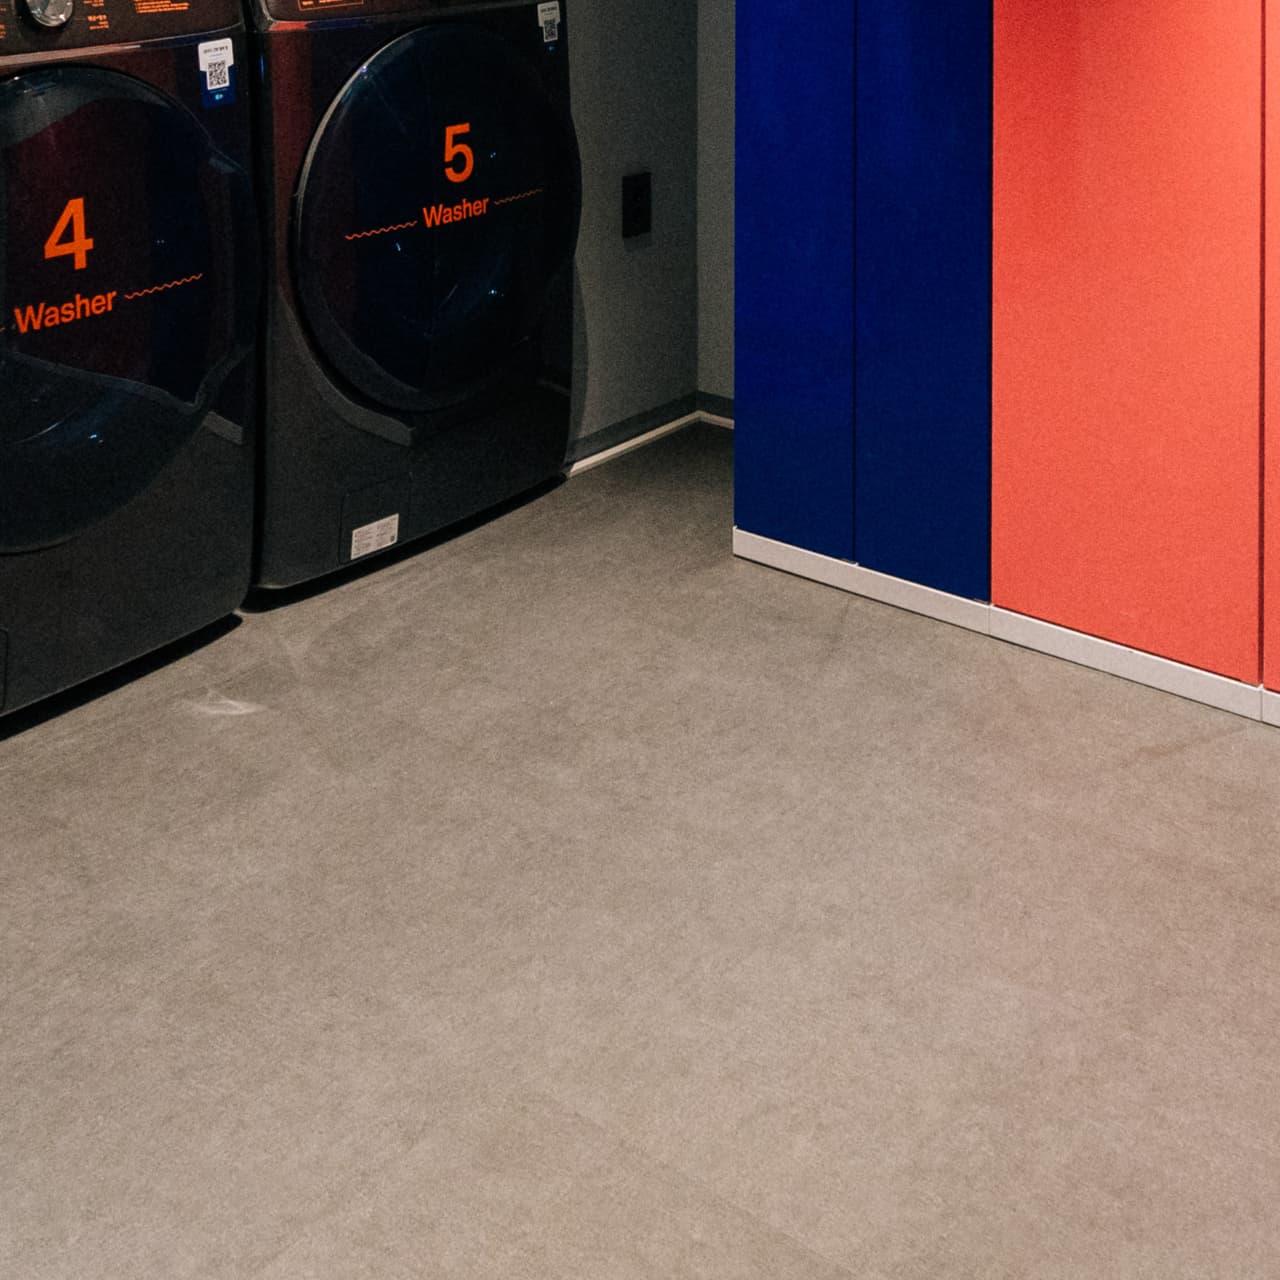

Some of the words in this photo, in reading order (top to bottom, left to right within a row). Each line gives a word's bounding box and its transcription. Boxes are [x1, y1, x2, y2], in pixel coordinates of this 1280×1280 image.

[444, 122, 475, 184] 5
[43, 197, 95, 271] 4
[422, 196, 490, 229] Washer
[13, 289, 118, 334] Washer
